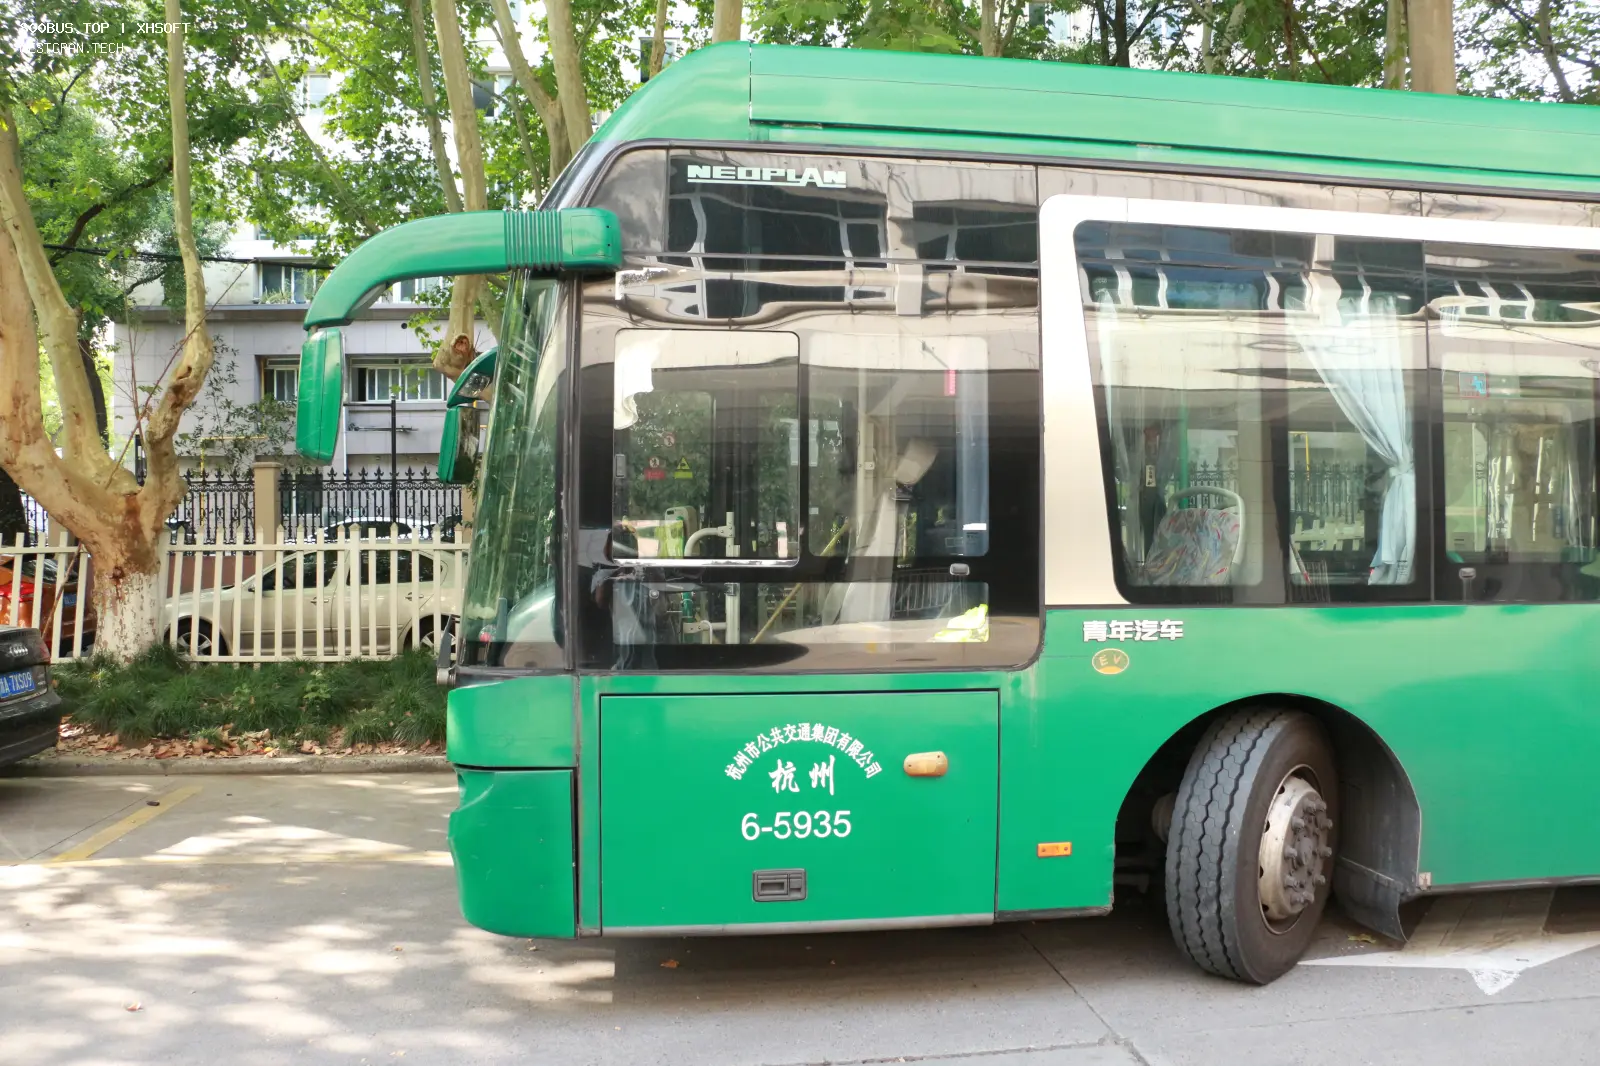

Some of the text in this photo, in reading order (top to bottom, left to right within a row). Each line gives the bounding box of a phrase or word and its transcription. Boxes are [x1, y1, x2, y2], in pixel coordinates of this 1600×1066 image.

[688, 165, 846, 188] NEOPLAN
[1083, 619, 1184, 642] 青年汽车
[724, 723, 882, 781] 杭州市公共交通集团有限公司
[768, 755, 835, 796] 杭州
[741, 810, 851, 840] 6-5935
